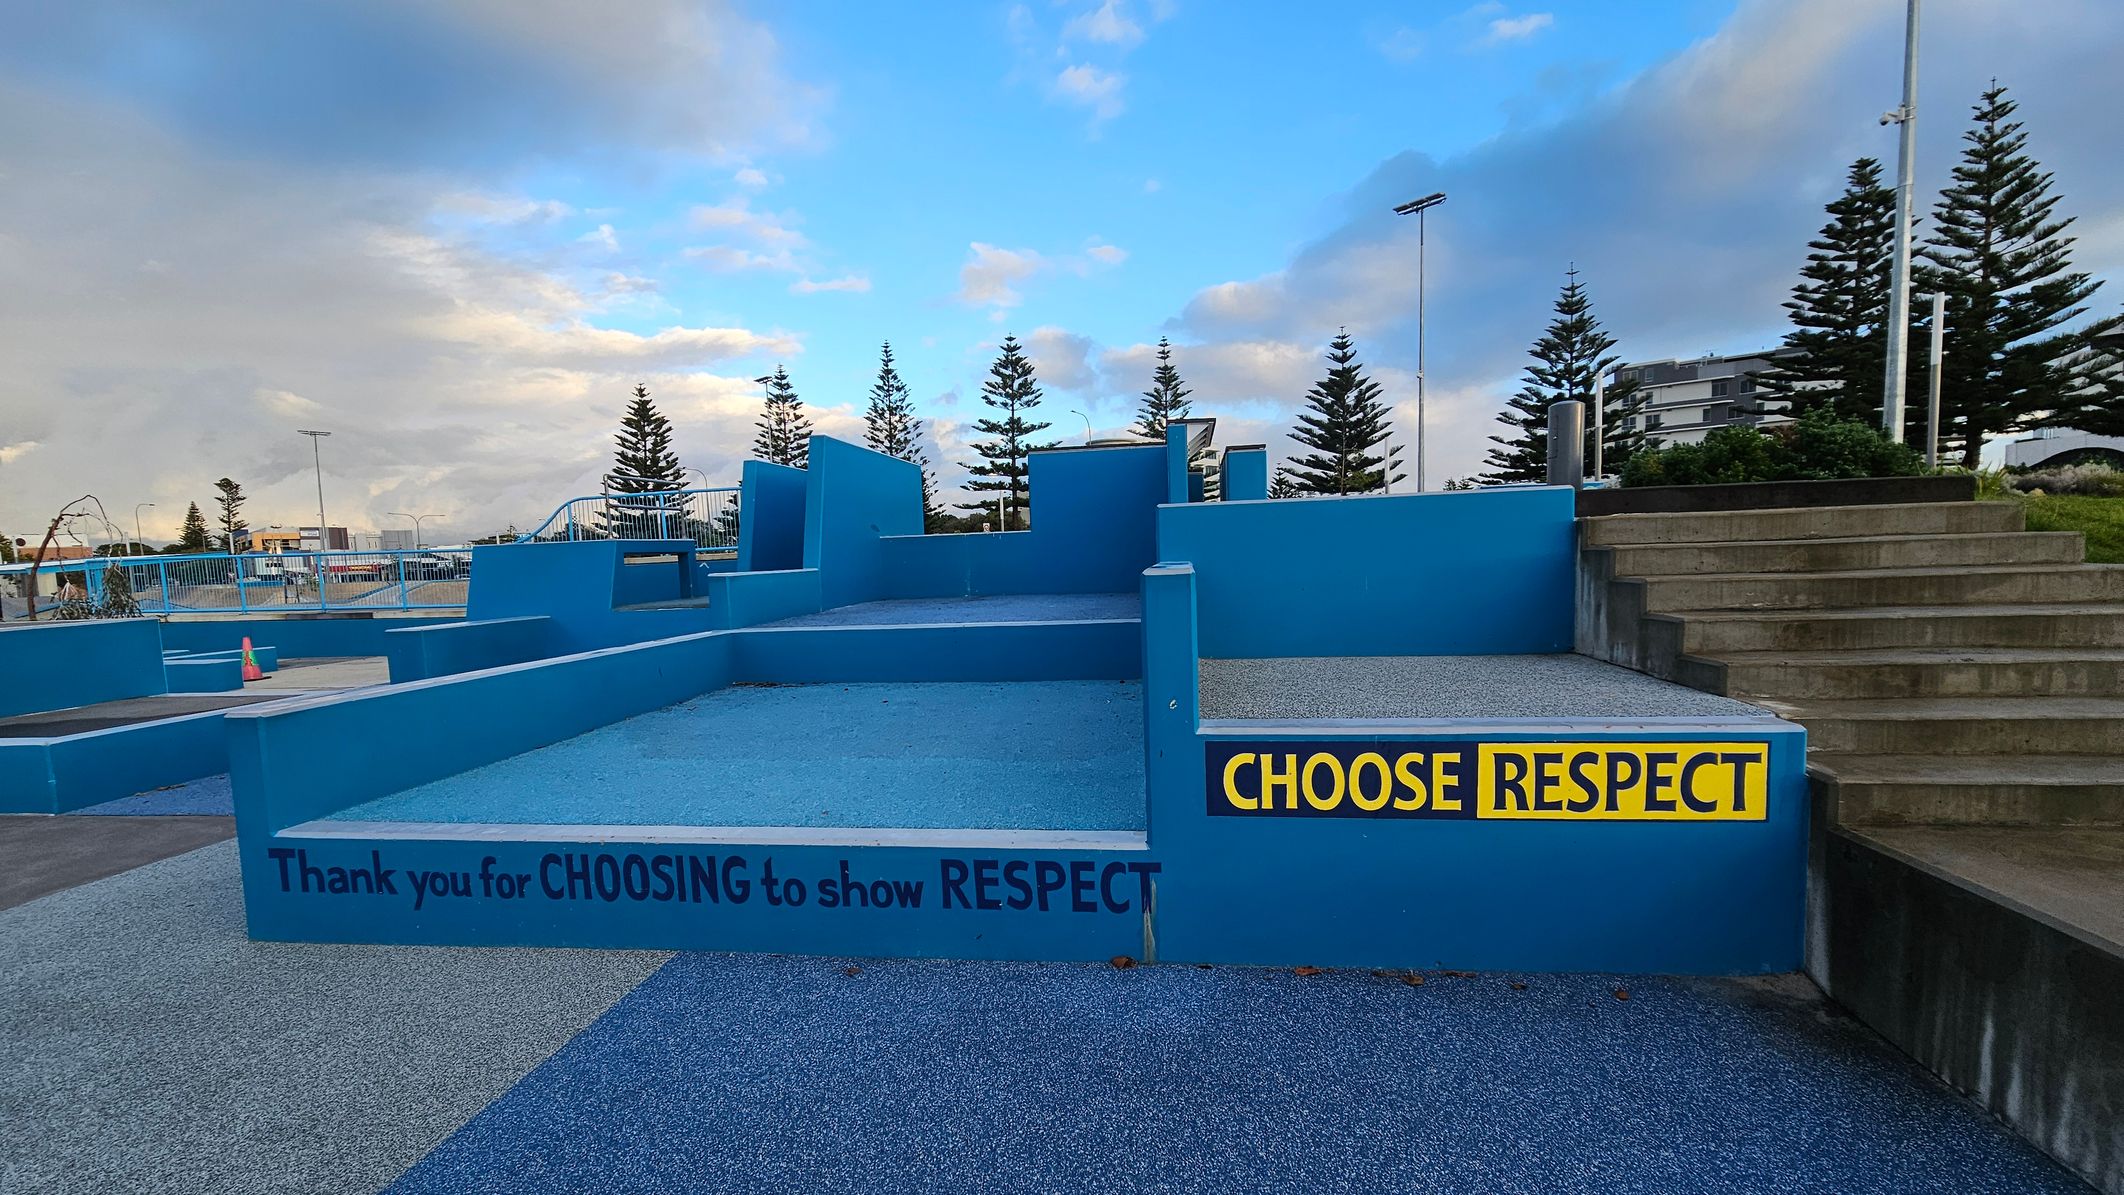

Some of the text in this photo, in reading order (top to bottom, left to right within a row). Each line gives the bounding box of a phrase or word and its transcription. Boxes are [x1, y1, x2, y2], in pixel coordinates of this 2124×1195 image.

[1222, 752, 1763, 812] CHOOSE RESPECT
[267, 849, 1161, 913] Thank you for CHOOSING to show RESPECT
